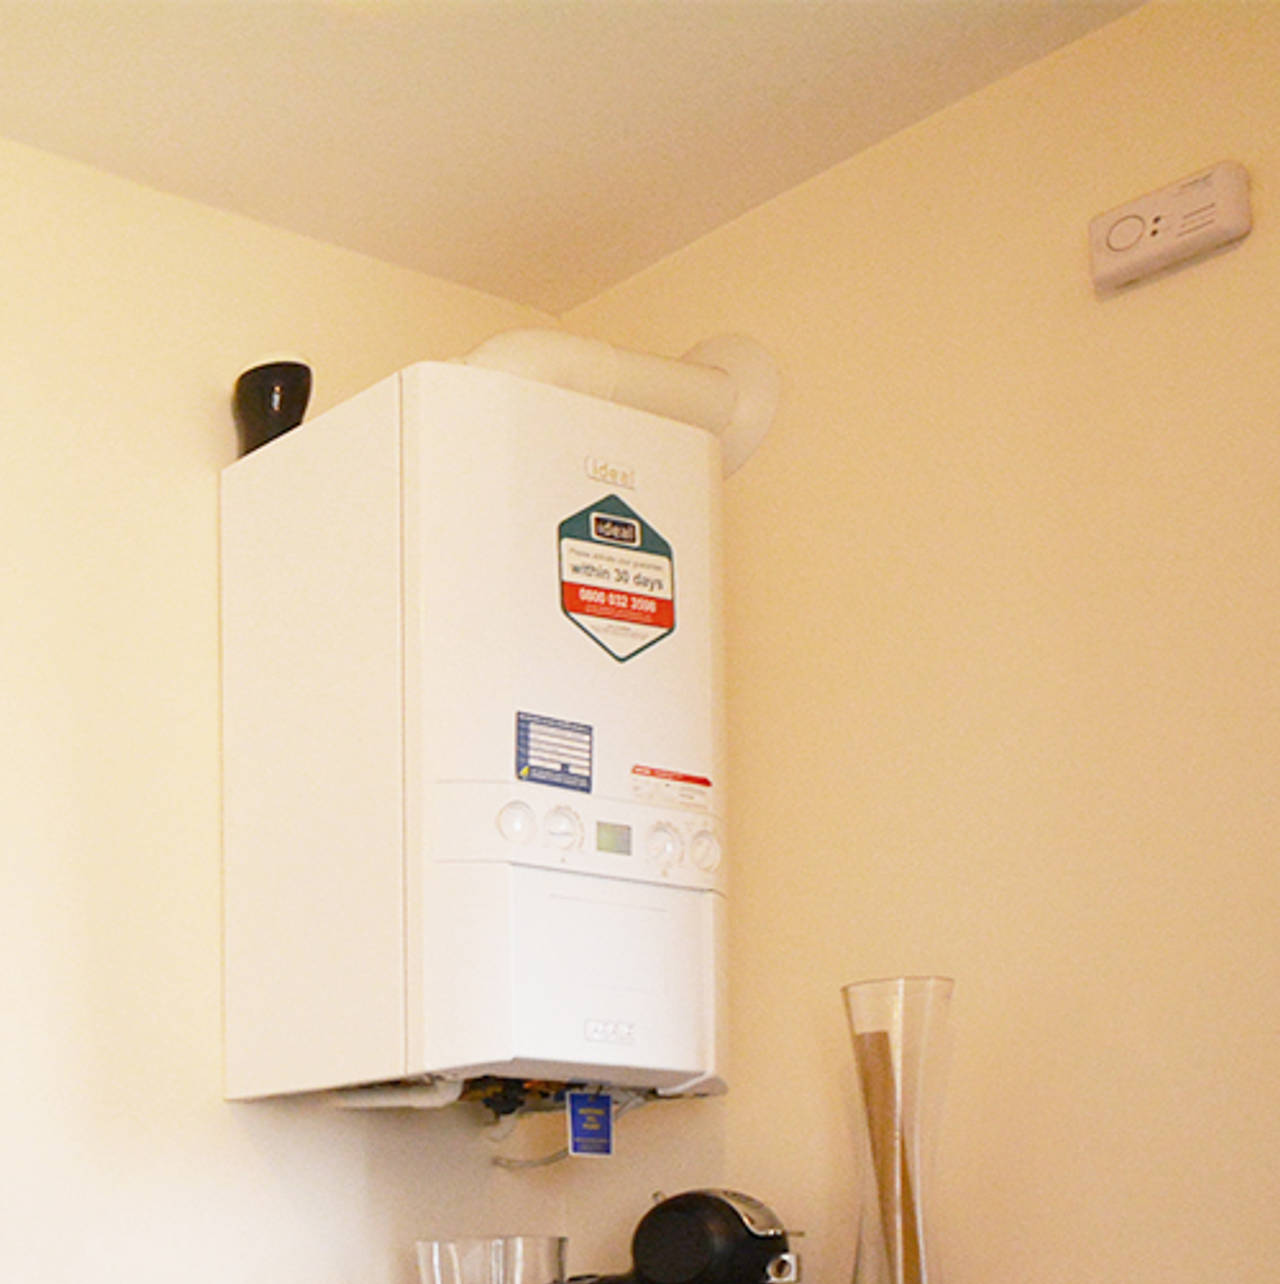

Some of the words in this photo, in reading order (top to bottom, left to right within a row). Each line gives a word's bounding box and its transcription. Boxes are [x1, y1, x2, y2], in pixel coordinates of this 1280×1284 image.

[570, 563, 610, 580] within
[613, 567, 630, 583] 30
[633, 573, 664, 592] days
